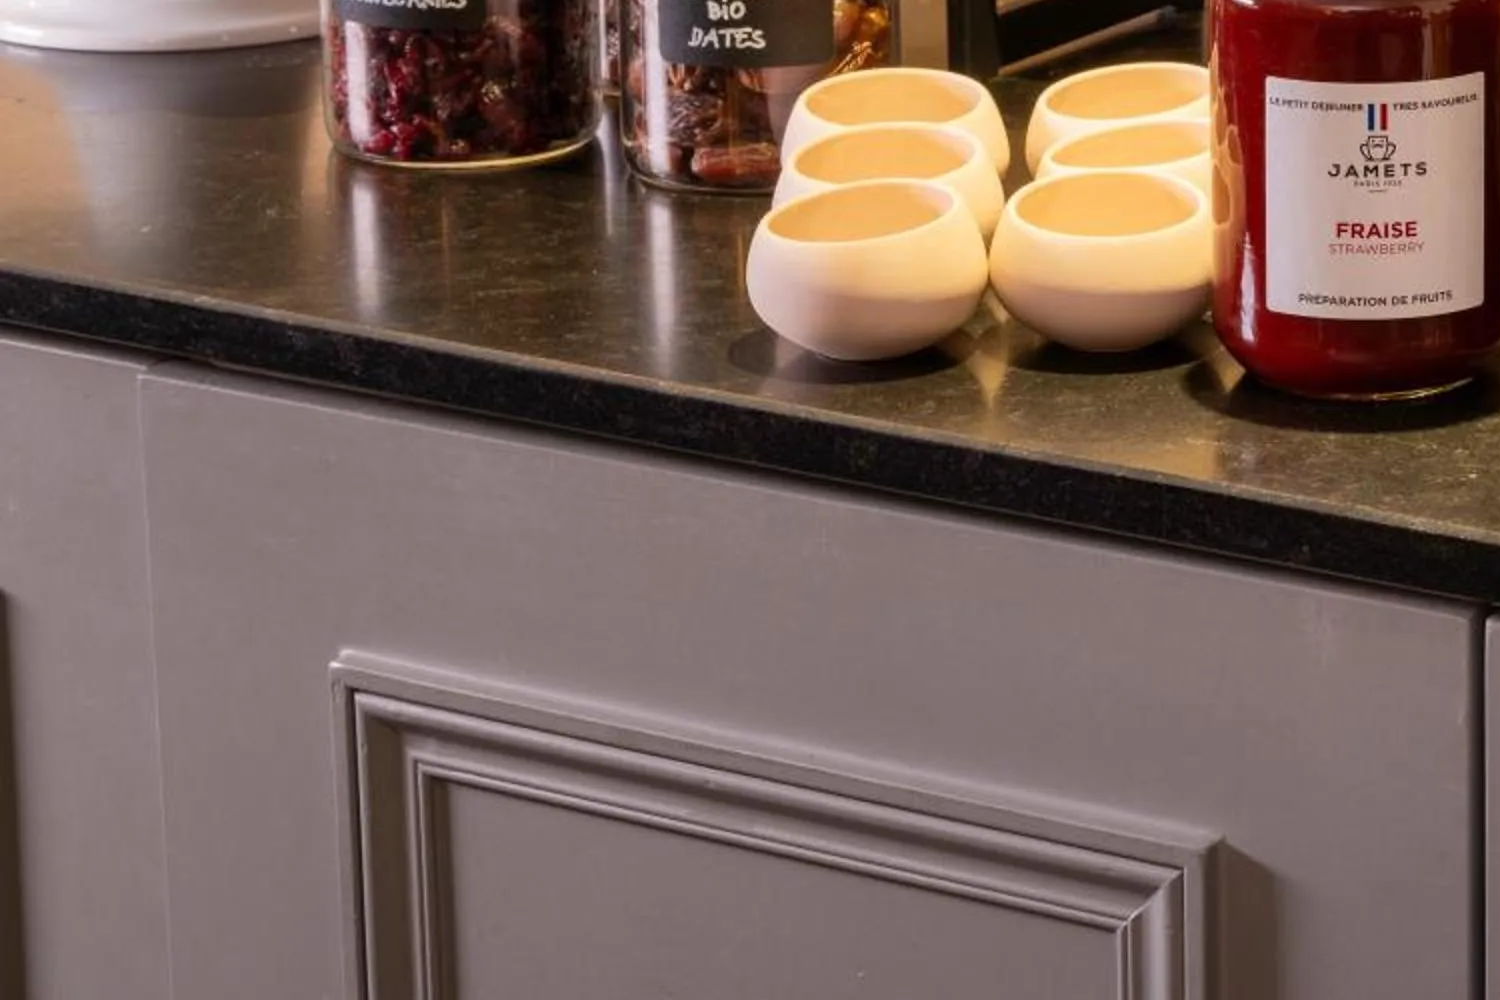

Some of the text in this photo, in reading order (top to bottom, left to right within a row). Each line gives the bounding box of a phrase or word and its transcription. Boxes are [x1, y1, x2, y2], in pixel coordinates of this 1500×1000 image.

[688, 26, 767, 49] DATES
[1327, 161, 1427, 178] JAMETS
[1336, 221, 1418, 239] FRAISE
[1329, 241, 1425, 256] STRAWBERRY
[1391, 296, 1409, 306] DE
[1411, 290, 1453, 304] FRUITS
